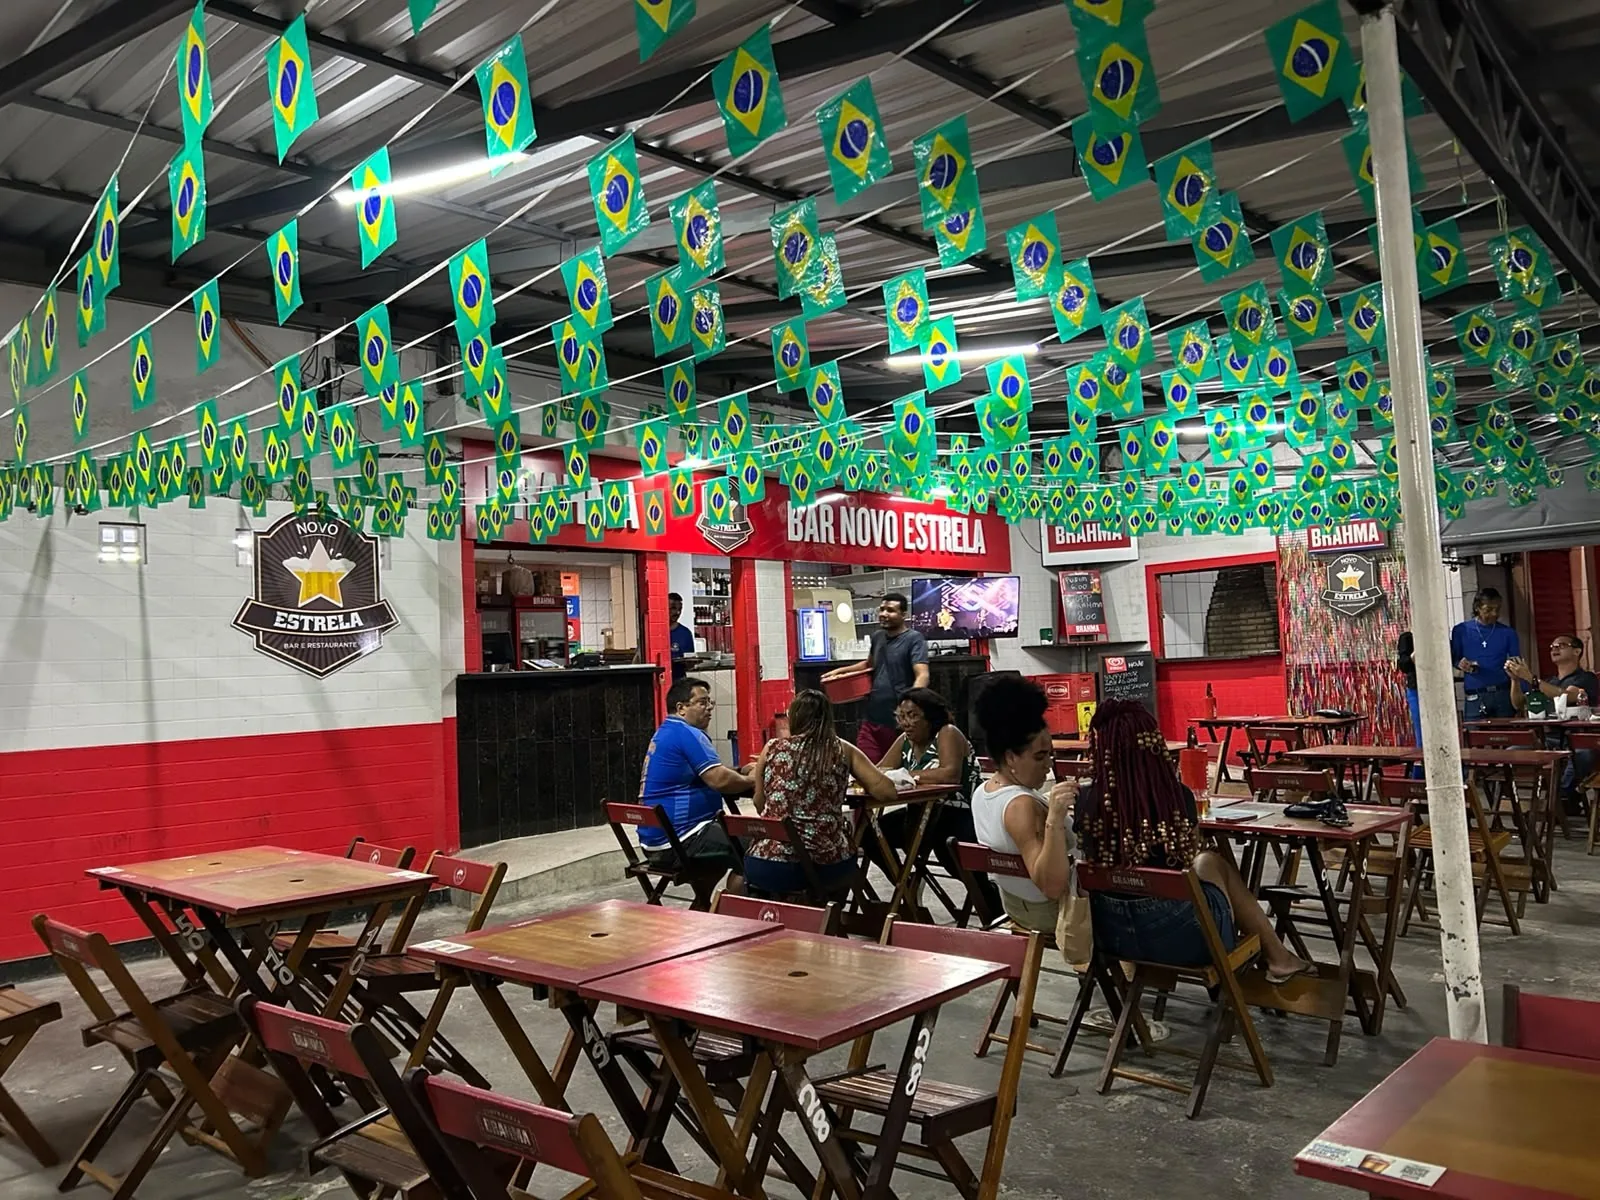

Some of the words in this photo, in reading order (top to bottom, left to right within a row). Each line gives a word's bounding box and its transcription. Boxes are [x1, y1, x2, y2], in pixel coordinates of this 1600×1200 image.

[296, 521, 339, 537] NOVO
[788, 500, 835, 544] BAR
[840, 506, 898, 549] NOVO
[904, 511, 986, 554] ESTRELA
[1310, 522, 1380, 548] BRAHMA
[1334, 592, 1369, 601] ESTRELA
[273, 611, 364, 632] ESTRELA
[307, 641, 358, 649] RESTAURANTE
[175, 914, 205, 951] 50
[349, 926, 379, 976] 10
[582, 1015, 611, 1069] 49
[904, 1027, 930, 1097] 28
[798, 1083, 830, 1143] 28
